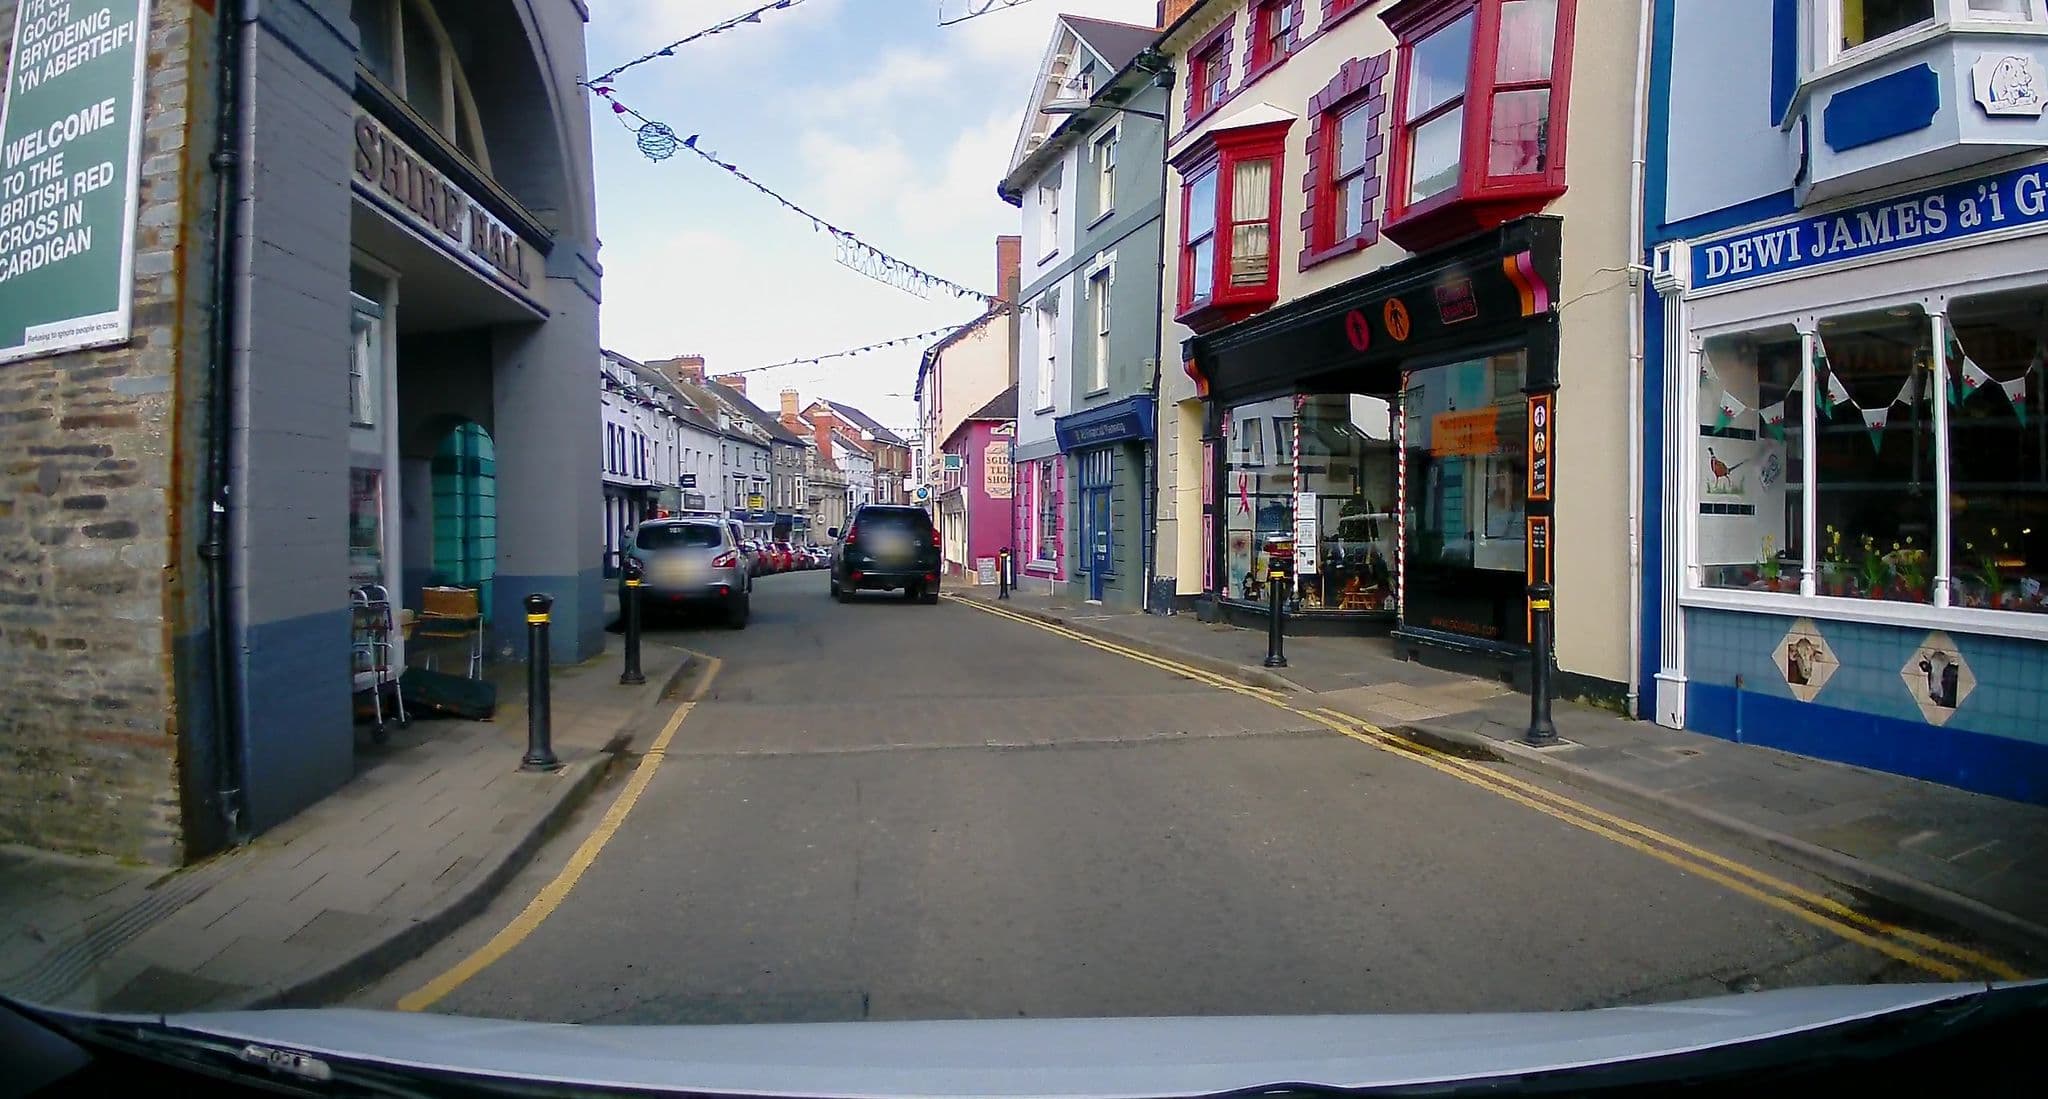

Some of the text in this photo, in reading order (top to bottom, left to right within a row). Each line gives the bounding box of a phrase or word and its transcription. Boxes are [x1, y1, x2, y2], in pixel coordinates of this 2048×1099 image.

[20, 8, 111, 71] BRYDEINIG
[23, 3, 70, 45] GOCH
[19, 20, 134, 94] YN ABERTEIFI
[6, 97, 116, 169] WELCOME
[0, 161, 114, 228] BRITISH RED
[3, 152, 64, 199] TO THE
[356, 116, 529, 290] SHIRE HALL
[0, 200, 83, 253] CROSS IN
[0, 226, 91, 283] CARDIGAN
[1705, 172, 2048, 280] DEWI JAMES a'i G
